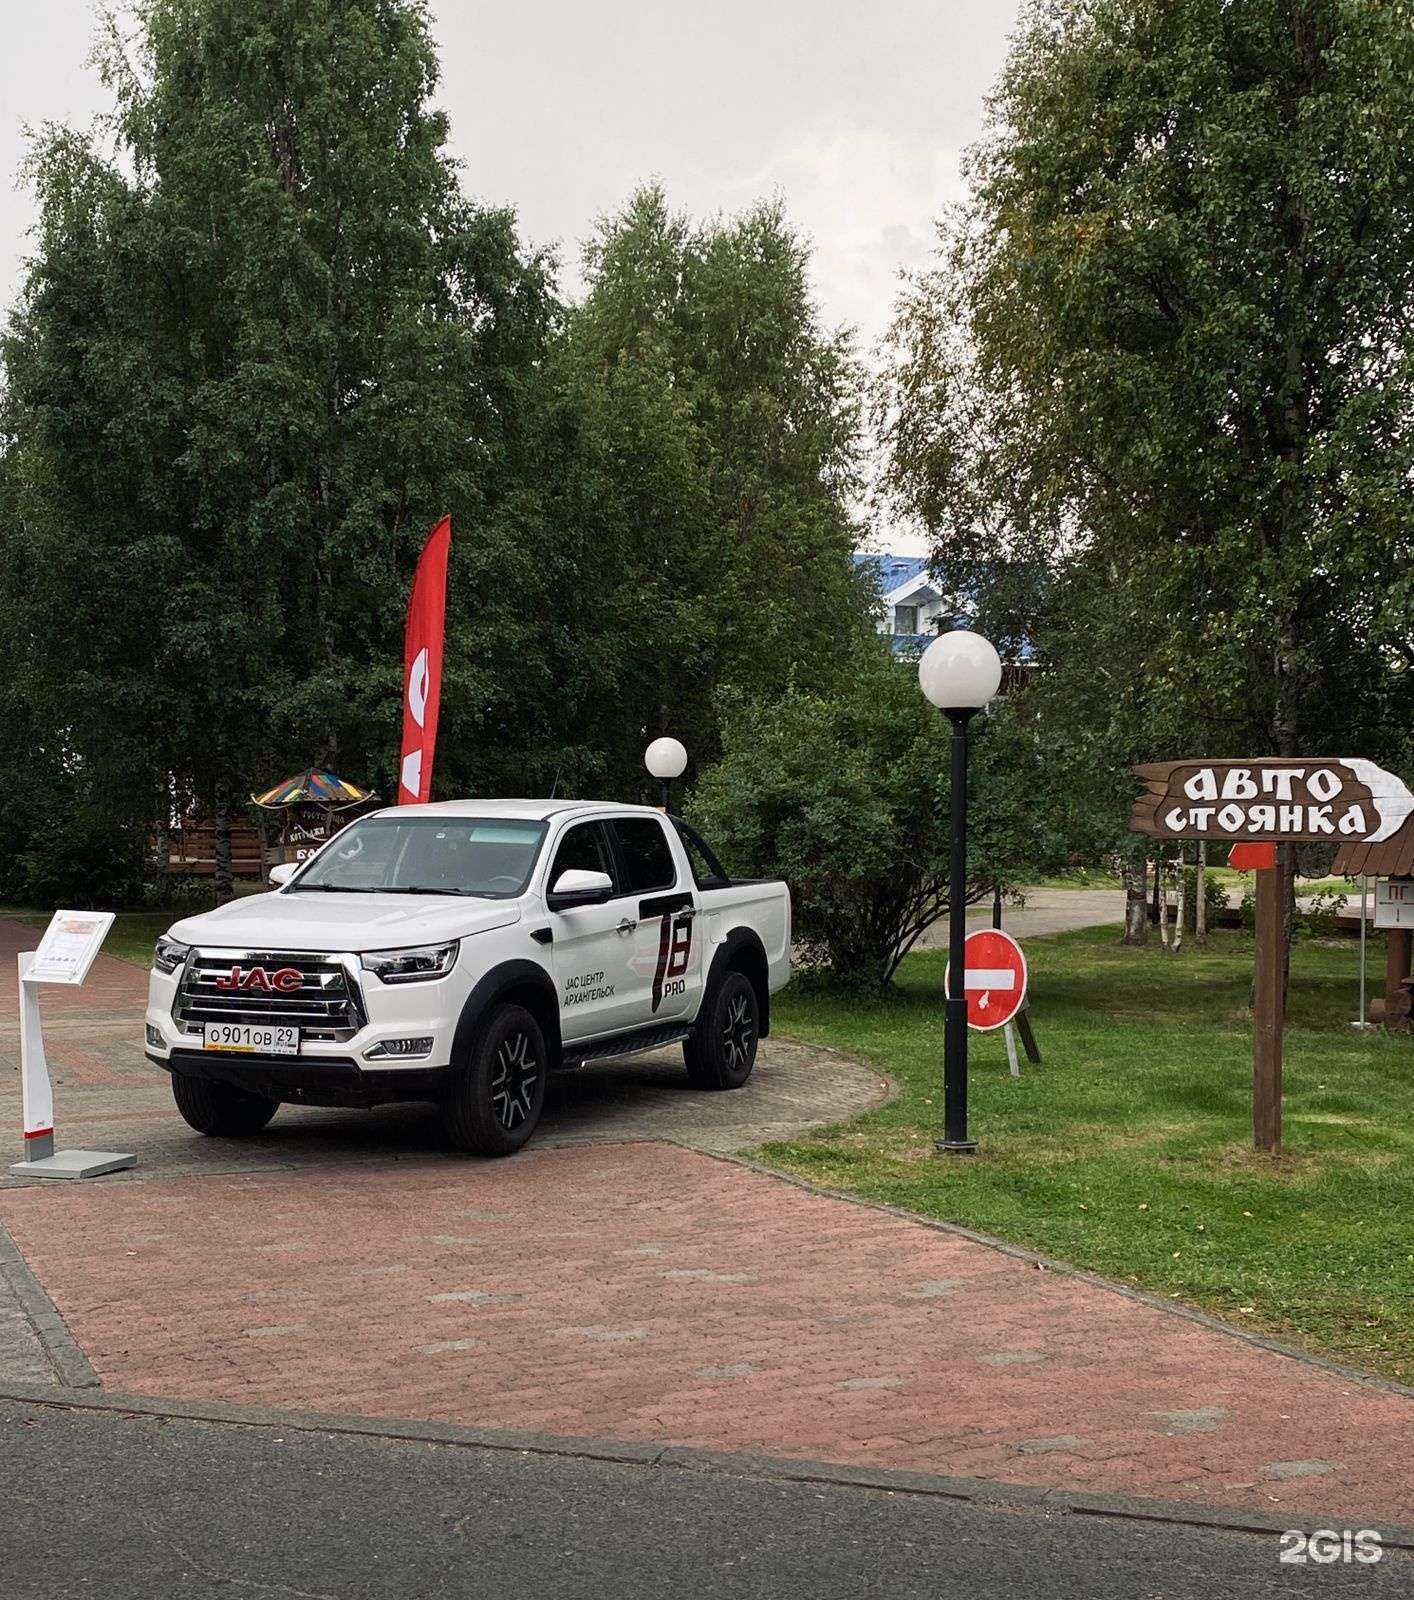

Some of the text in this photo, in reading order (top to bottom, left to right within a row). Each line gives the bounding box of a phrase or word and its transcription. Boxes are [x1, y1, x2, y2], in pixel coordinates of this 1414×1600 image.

[216, 966, 304, 992] JAC
[580, 971, 605, 988] ЦЕНТР
[663, 979, 686, 998] PRO
[563, 985, 615, 1007] АРХАНГЕЛЬСК
[277, 1028, 293, 1042] 29
